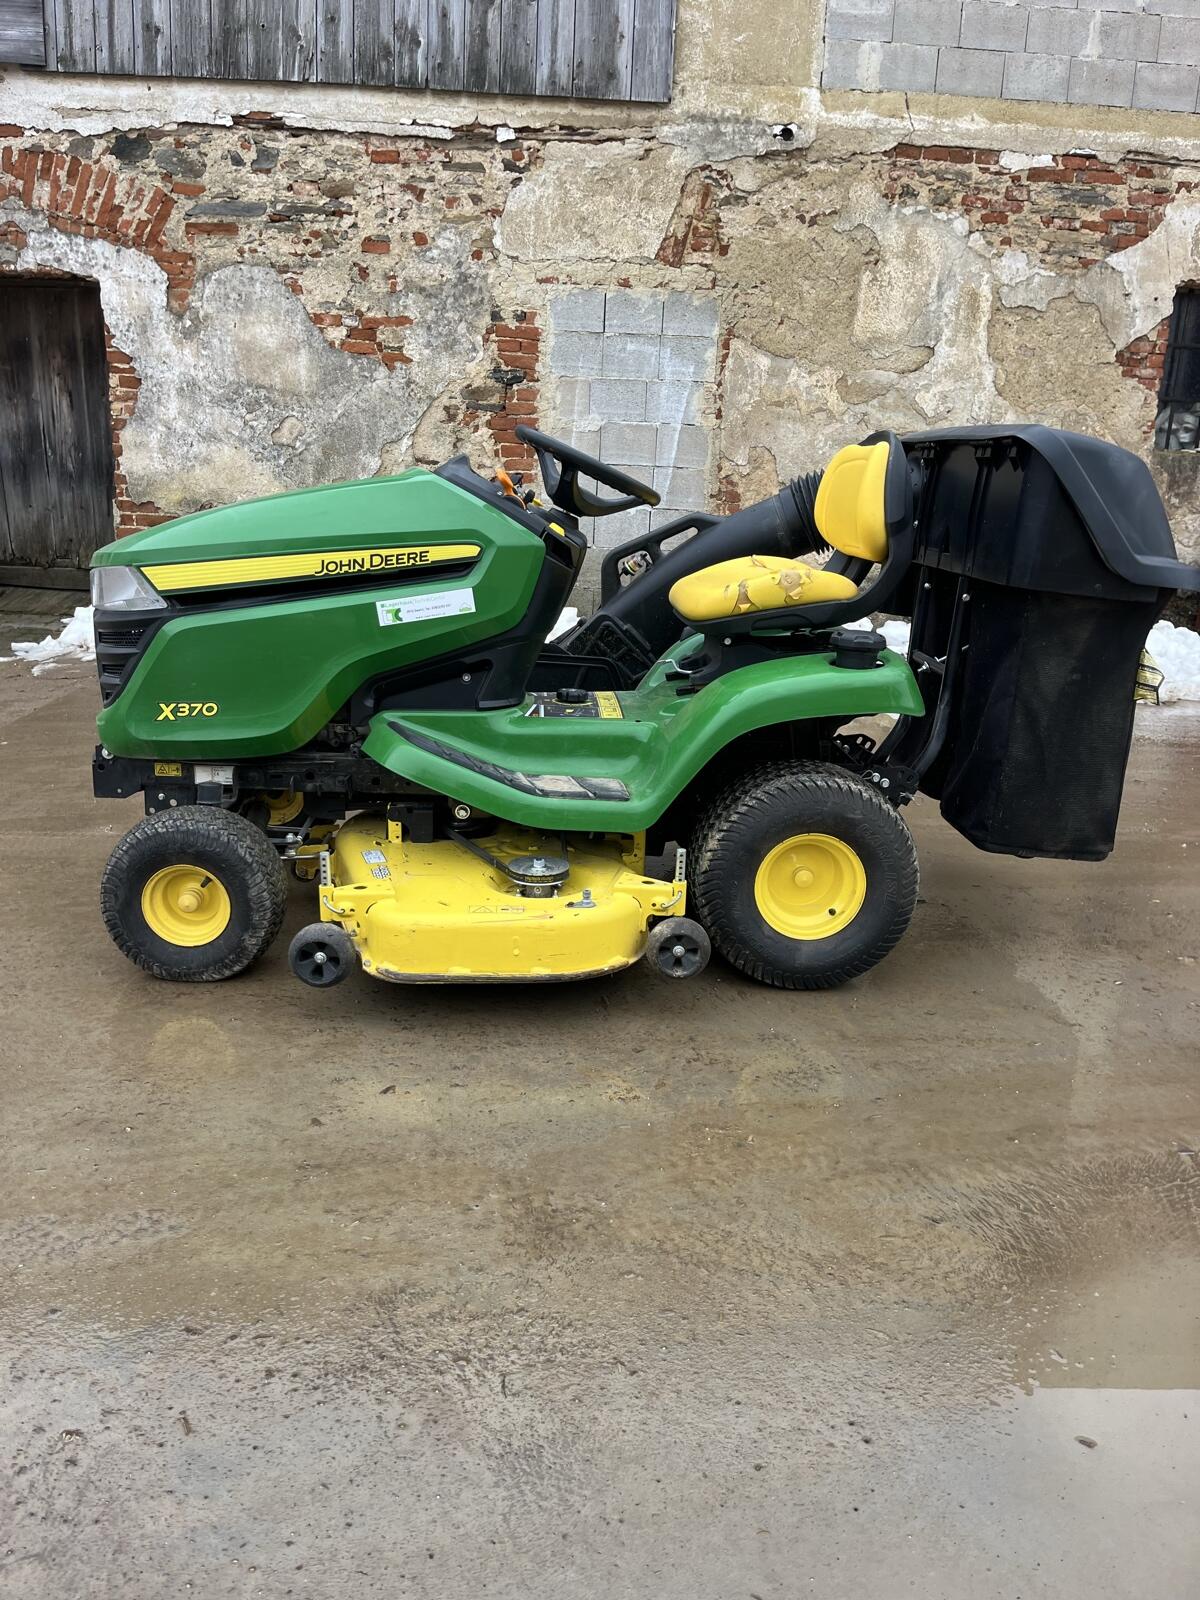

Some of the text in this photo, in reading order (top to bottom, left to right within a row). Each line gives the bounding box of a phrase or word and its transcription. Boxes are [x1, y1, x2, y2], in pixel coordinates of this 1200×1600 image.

[315, 550, 430, 575] JOHN DEERE
[156, 702, 219, 721] X370
